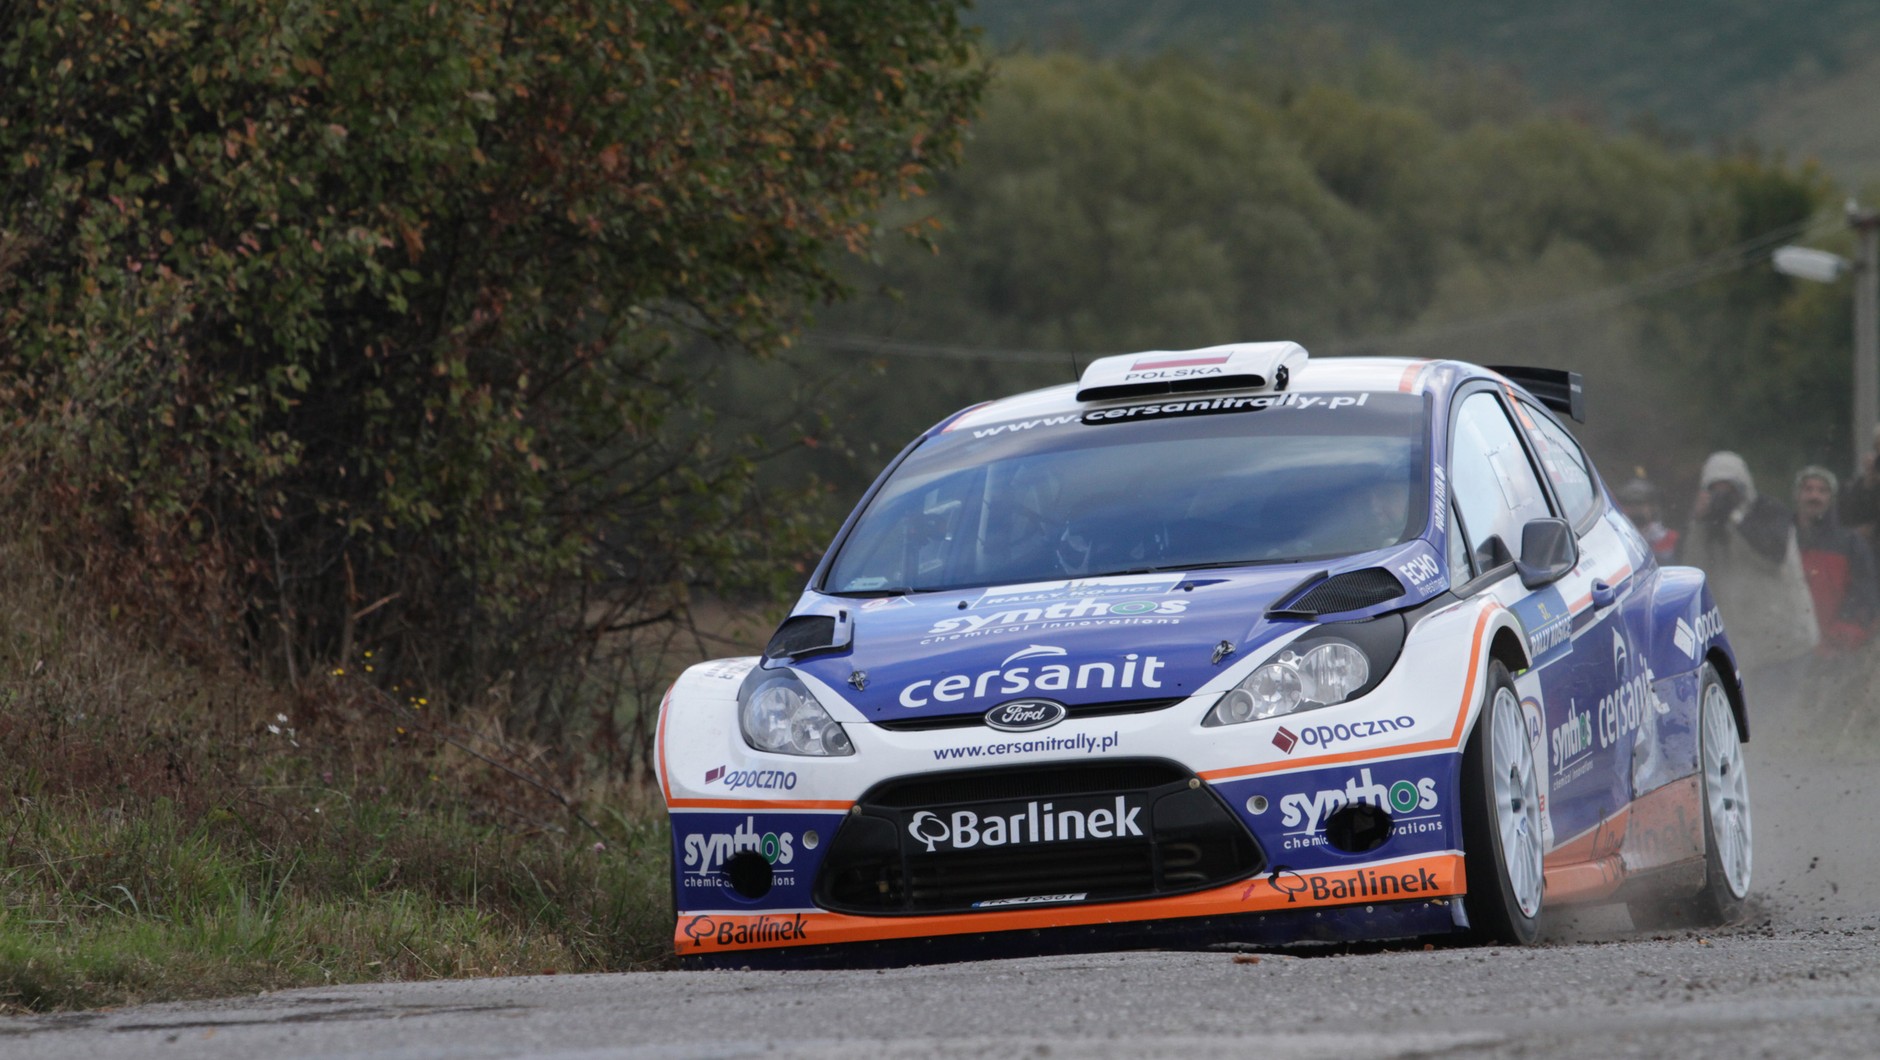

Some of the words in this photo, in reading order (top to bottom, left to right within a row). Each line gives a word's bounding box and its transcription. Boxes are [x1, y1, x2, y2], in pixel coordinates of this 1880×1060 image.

[1125, 367, 1223, 381] POLSKA
[972, 392, 1369, 439] www.cersanitrally.pl
[1399, 553, 1440, 586] ECHO
[987, 592, 1063, 604] RALLY
[920, 624, 1029, 645] chemical
[1041, 617, 1181, 629] innovations
[928, 598, 1191, 634] synthos
[900, 653, 1165, 708] cersanit
[1001, 704, 1045, 723] Ford
[933, 731, 1119, 761] www.cersanitrally.pl
[1301, 716, 1415, 750] opoczno
[1552, 697, 1592, 776] synthos
[723, 770, 797, 791] opoczno
[1280, 768, 1438, 836] synthos
[951, 796, 1144, 848] Barlinek
[684, 816, 794, 877] synthos
[1284, 834, 1329, 850] chemic
[1310, 868, 1439, 900] Barlinek
[717, 913, 808, 945] Barlinek
